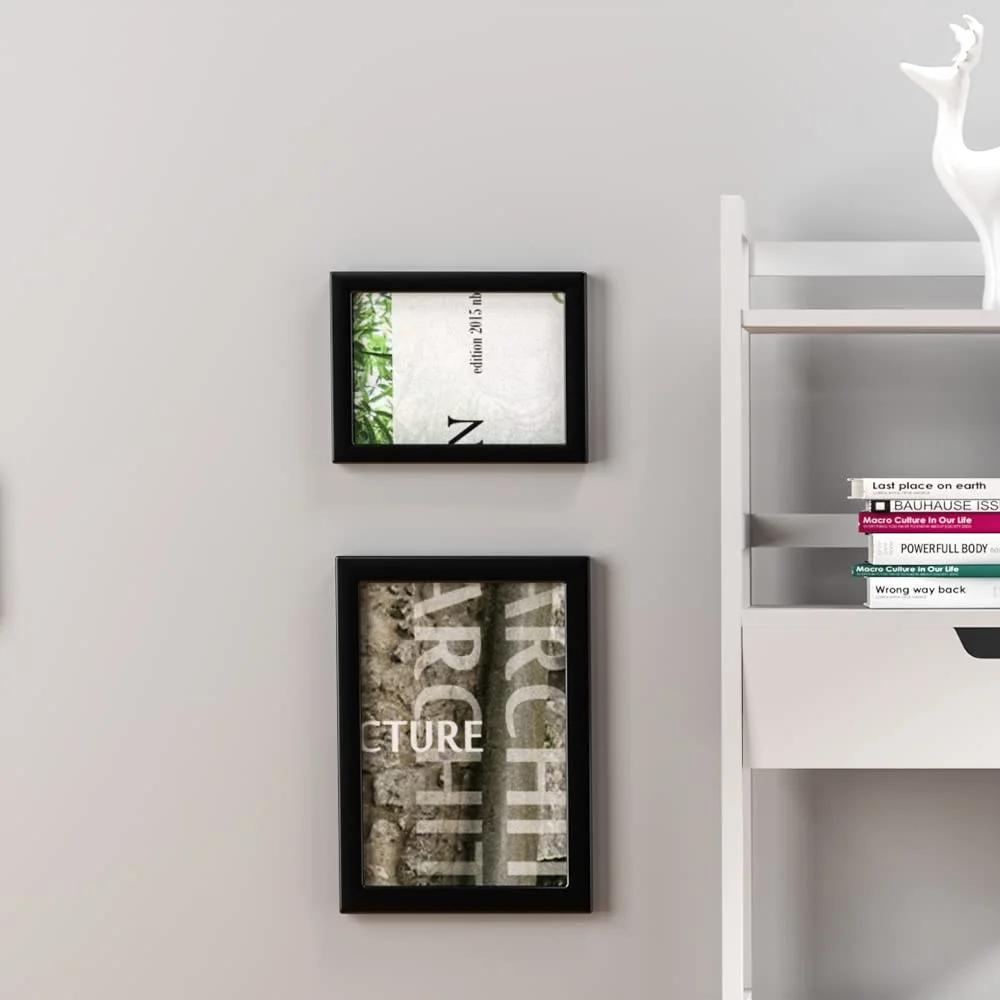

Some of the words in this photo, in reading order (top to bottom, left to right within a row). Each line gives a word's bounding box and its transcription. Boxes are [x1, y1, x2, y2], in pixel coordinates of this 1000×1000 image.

[469, 309, 483, 334] 2015
[470, 338, 483, 374] edition
[872, 481, 895, 490] Last
[899, 481, 934, 491] place
[956, 481, 987, 490] earth
[894, 500, 971, 511] BAUHAUSE
[863, 516, 892, 524] Macro
[894, 516, 925, 524] Culture
[928, 516, 936, 524] In
[938, 516, 957, 524] Our
[958, 516, 973, 524] Life
[901, 543, 960, 554] POWERFULL
[961, 543, 988, 554] BODY
[875, 586, 910, 595] Wrong
[913, 587, 935, 595] way
[938, 585, 966, 594] back
